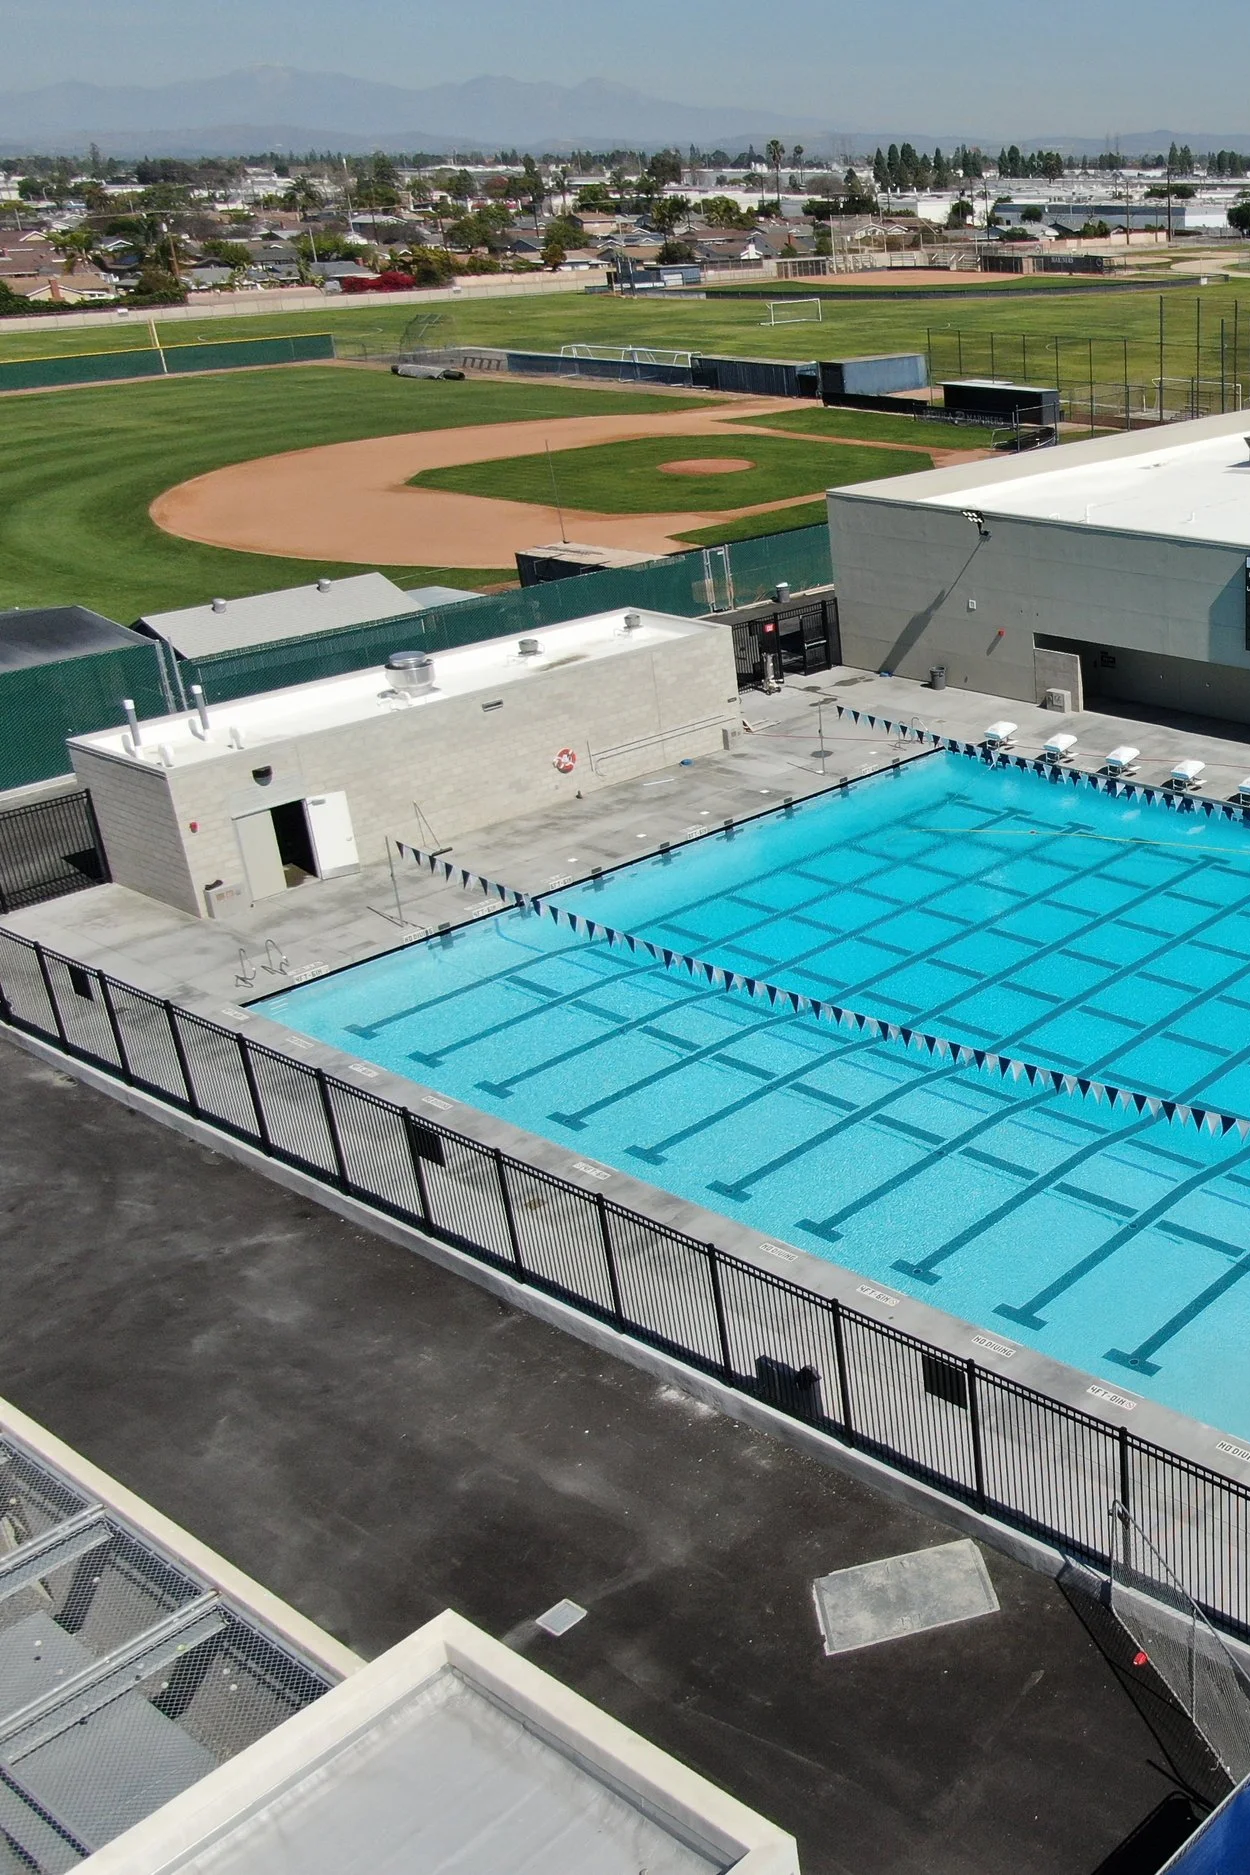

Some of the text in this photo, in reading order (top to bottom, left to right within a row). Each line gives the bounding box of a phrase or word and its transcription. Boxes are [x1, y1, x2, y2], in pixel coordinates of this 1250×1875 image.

[771, 1248, 796, 1261] DIVING
[974, 1336, 1014, 1357] NO DIVING
[1218, 1442, 1233, 1452] NO
